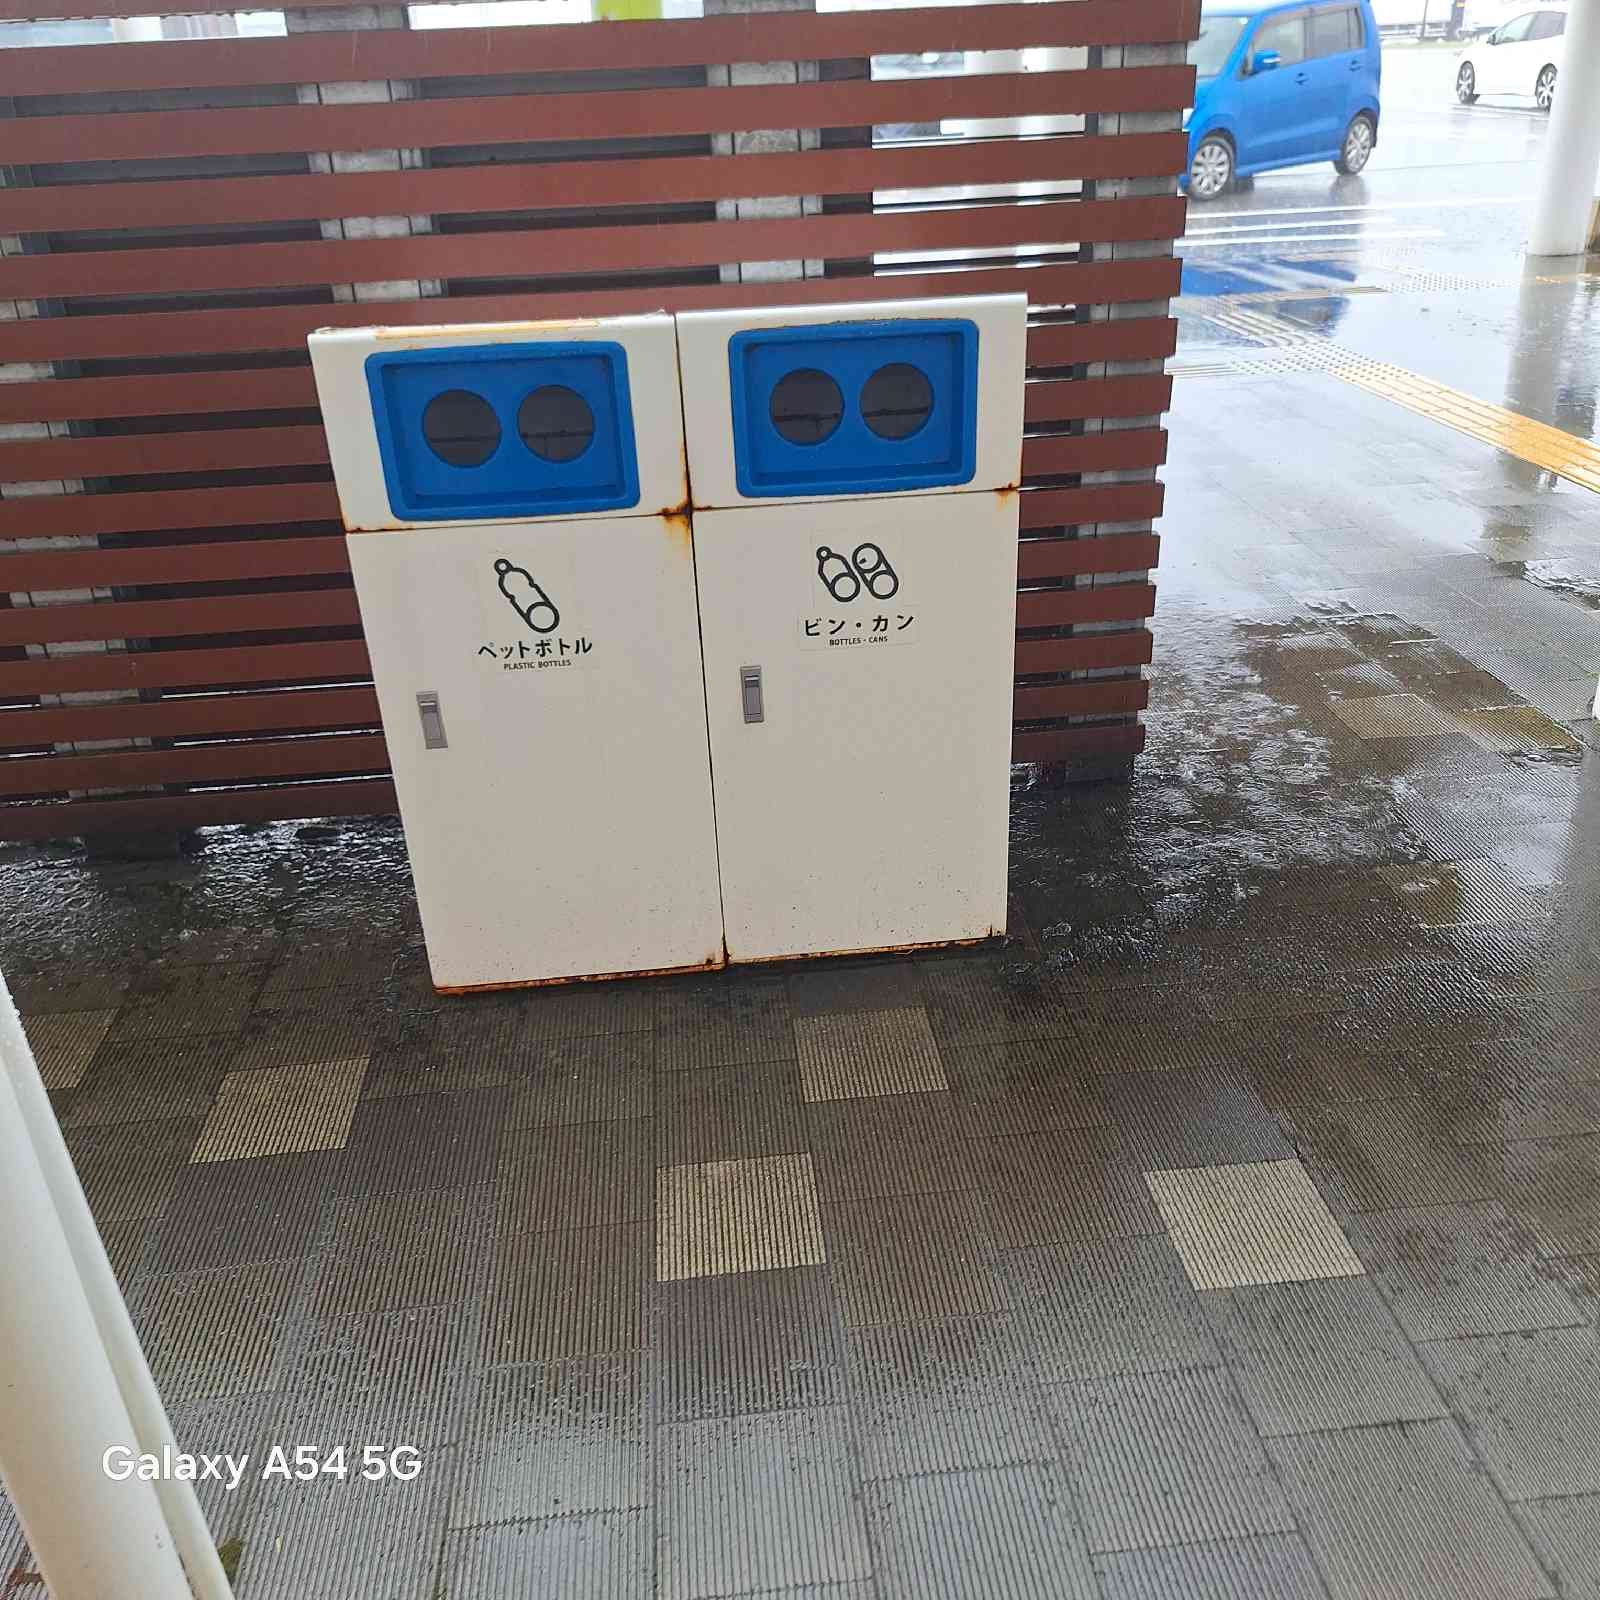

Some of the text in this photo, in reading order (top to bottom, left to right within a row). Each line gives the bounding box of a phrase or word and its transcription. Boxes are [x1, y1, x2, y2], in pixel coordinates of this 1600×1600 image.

[805, 615, 914, 637] ビン・カン
[478, 637, 593, 659] ペットボトル
[503, 659, 572, 671] PLASTIC BOTTLES
